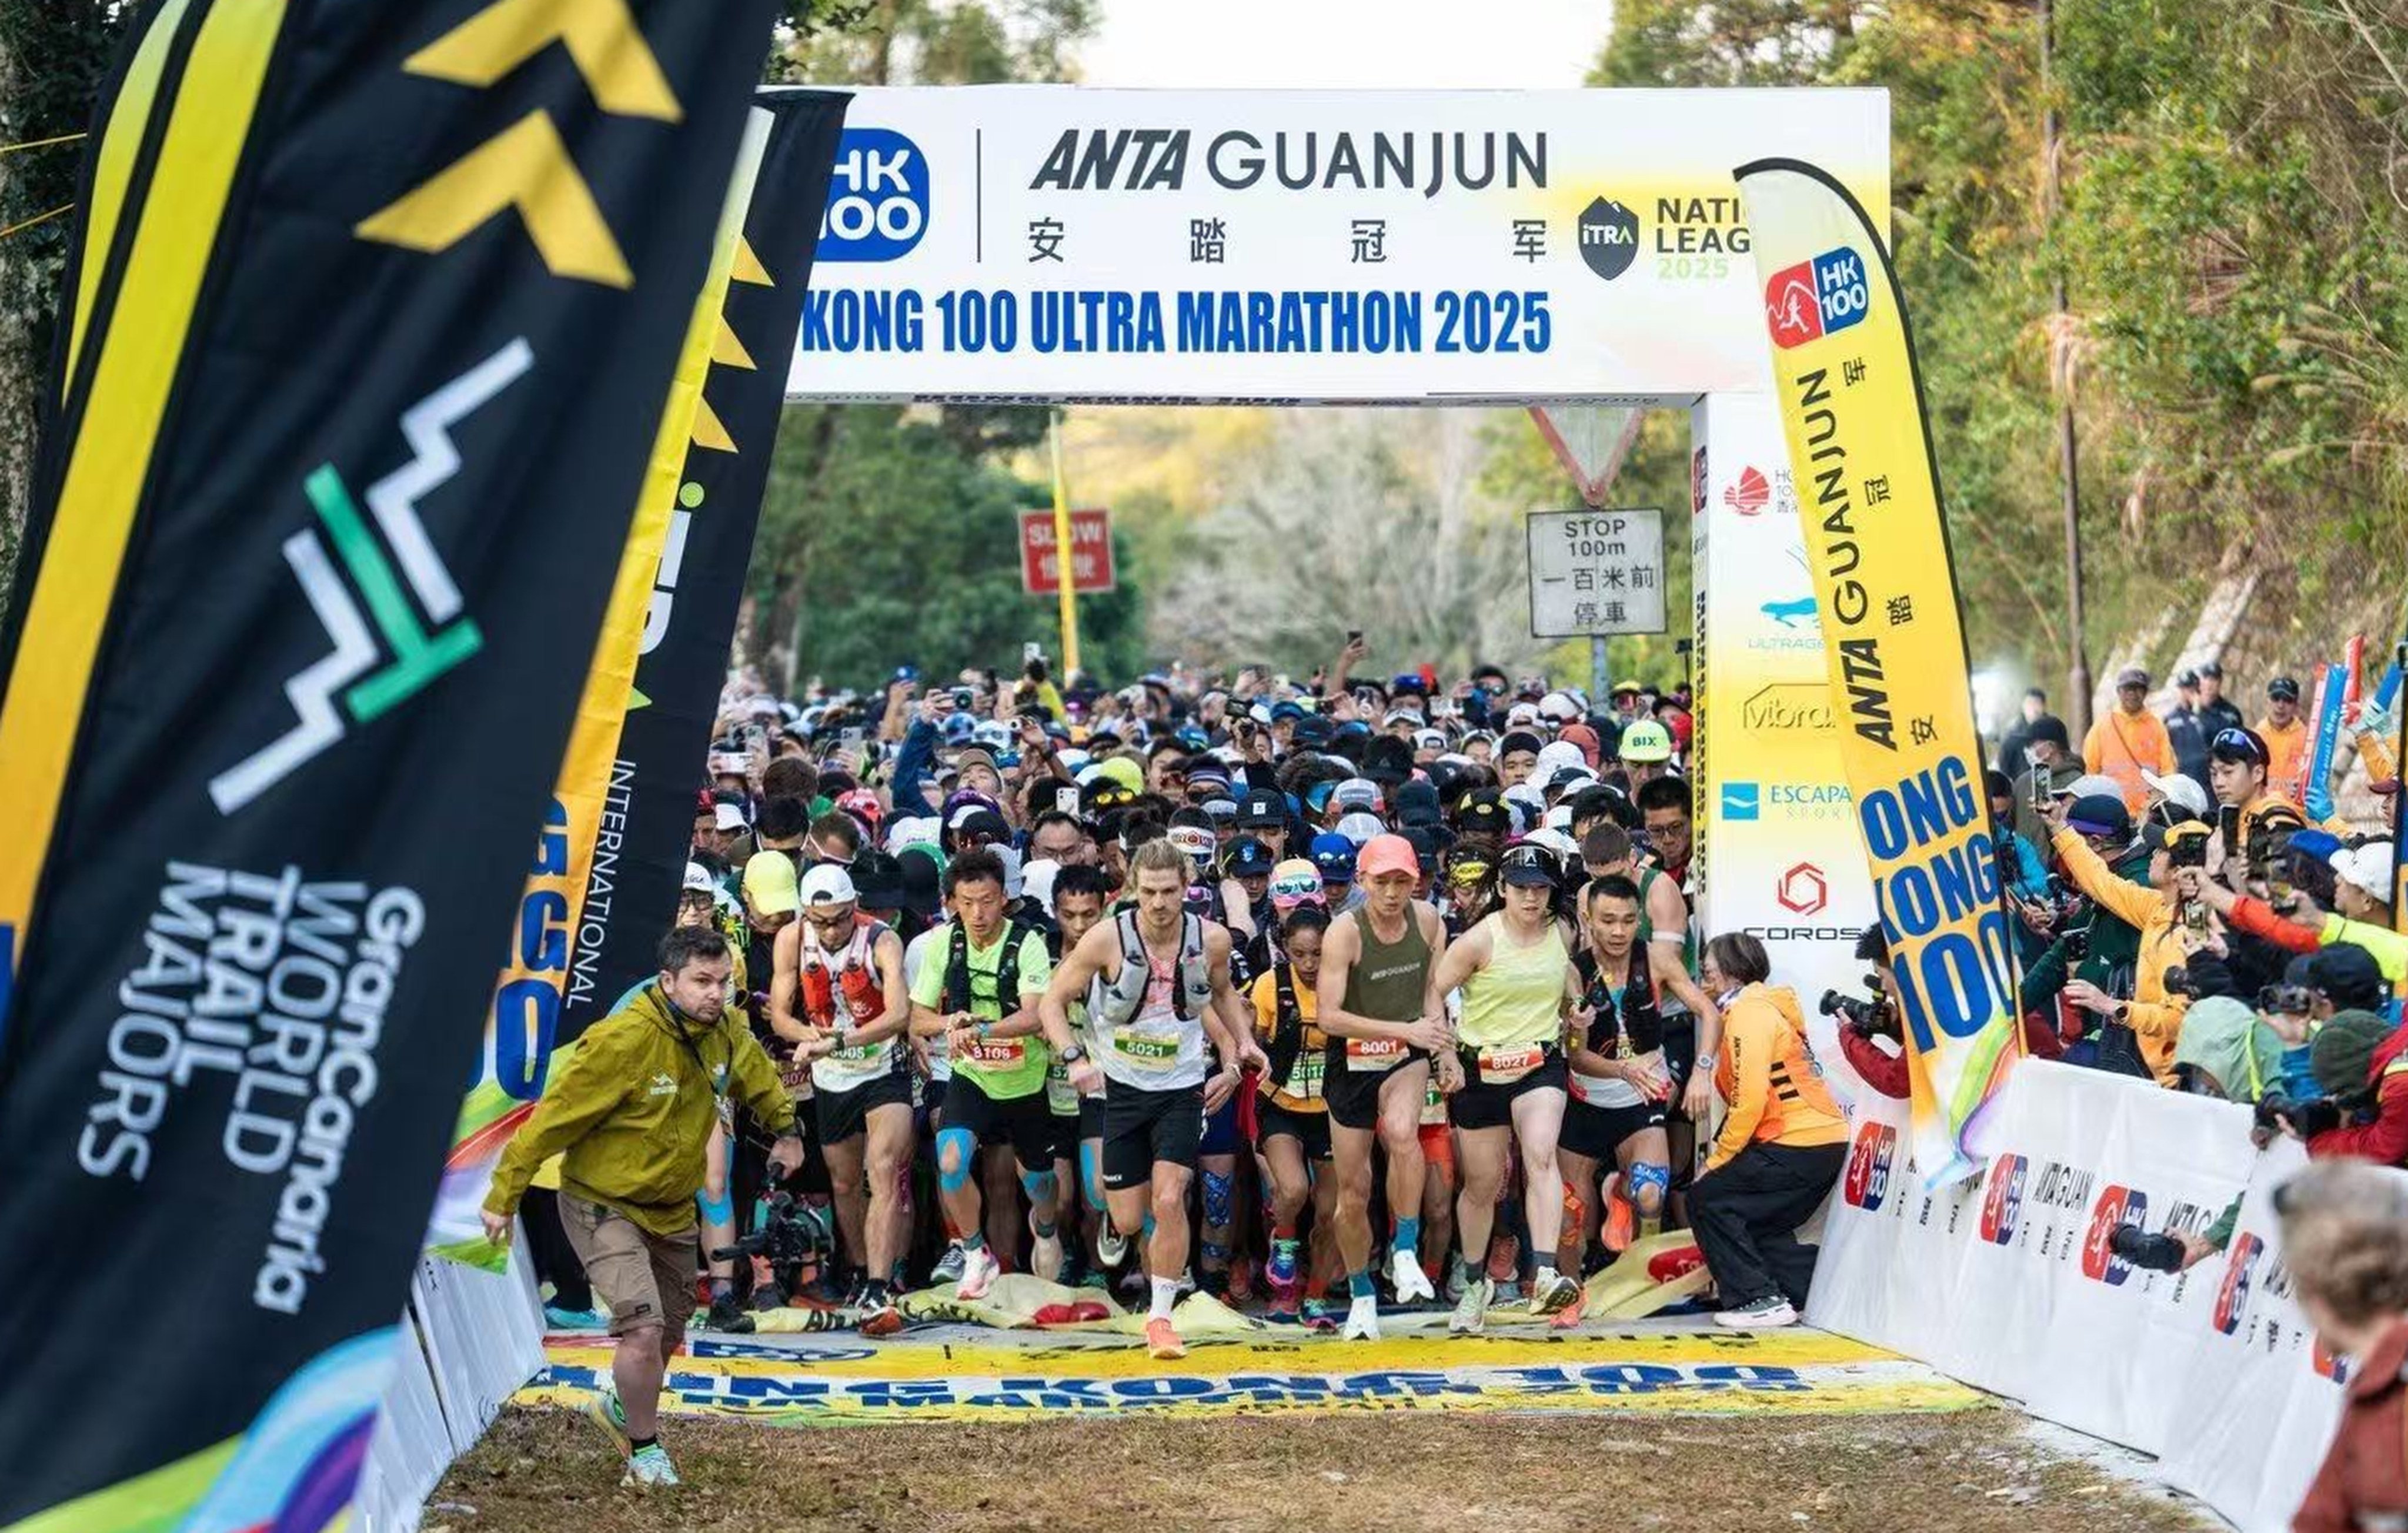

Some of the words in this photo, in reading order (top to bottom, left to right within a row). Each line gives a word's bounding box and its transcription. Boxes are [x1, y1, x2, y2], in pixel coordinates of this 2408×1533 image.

[1028, 129, 1191, 190] ANTA
[1206, 130, 1547, 199] GUANJUN
[819, 196, 921, 241] 00
[1656, 199, 1750, 223] NATI
[1656, 259, 1729, 279] 2025
[1822, 255, 1860, 292] HK
[801, 289, 924, 353] KONG
[935, 289, 1018, 353] 100
[1031, 290, 1165, 353] ULTRA
[1177, 290, 1421, 353] MARATHON
[1434, 290, 1551, 353] 2025
[1822, 286, 1867, 321] 100
[1796, 368, 1869, 626] GUANJUN
[1565, 519, 1626, 537] STOP
[1570, 539, 1626, 557] 100m
[1541, 564, 1654, 590] 一百米前
[1574, 601, 1628, 627] 停車
[1839, 638, 1898, 752] ANTA
[1632, 736, 1656, 747] BIX
[566, 759, 636, 1010] INTERNATIONAL
[1744, 927, 1861, 940] COROS
[171, 864, 302, 1088] TRAIL
[77, 859, 229, 1182] MAJORS
[222, 881, 368, 1175] WORLD
[1127, 1041, 1163, 1057] 5021
[1361, 1041, 1397, 1054] 8001
[1492, 1056, 1528, 1070] 8027
[253, 886, 426, 1315] GranCanaria
